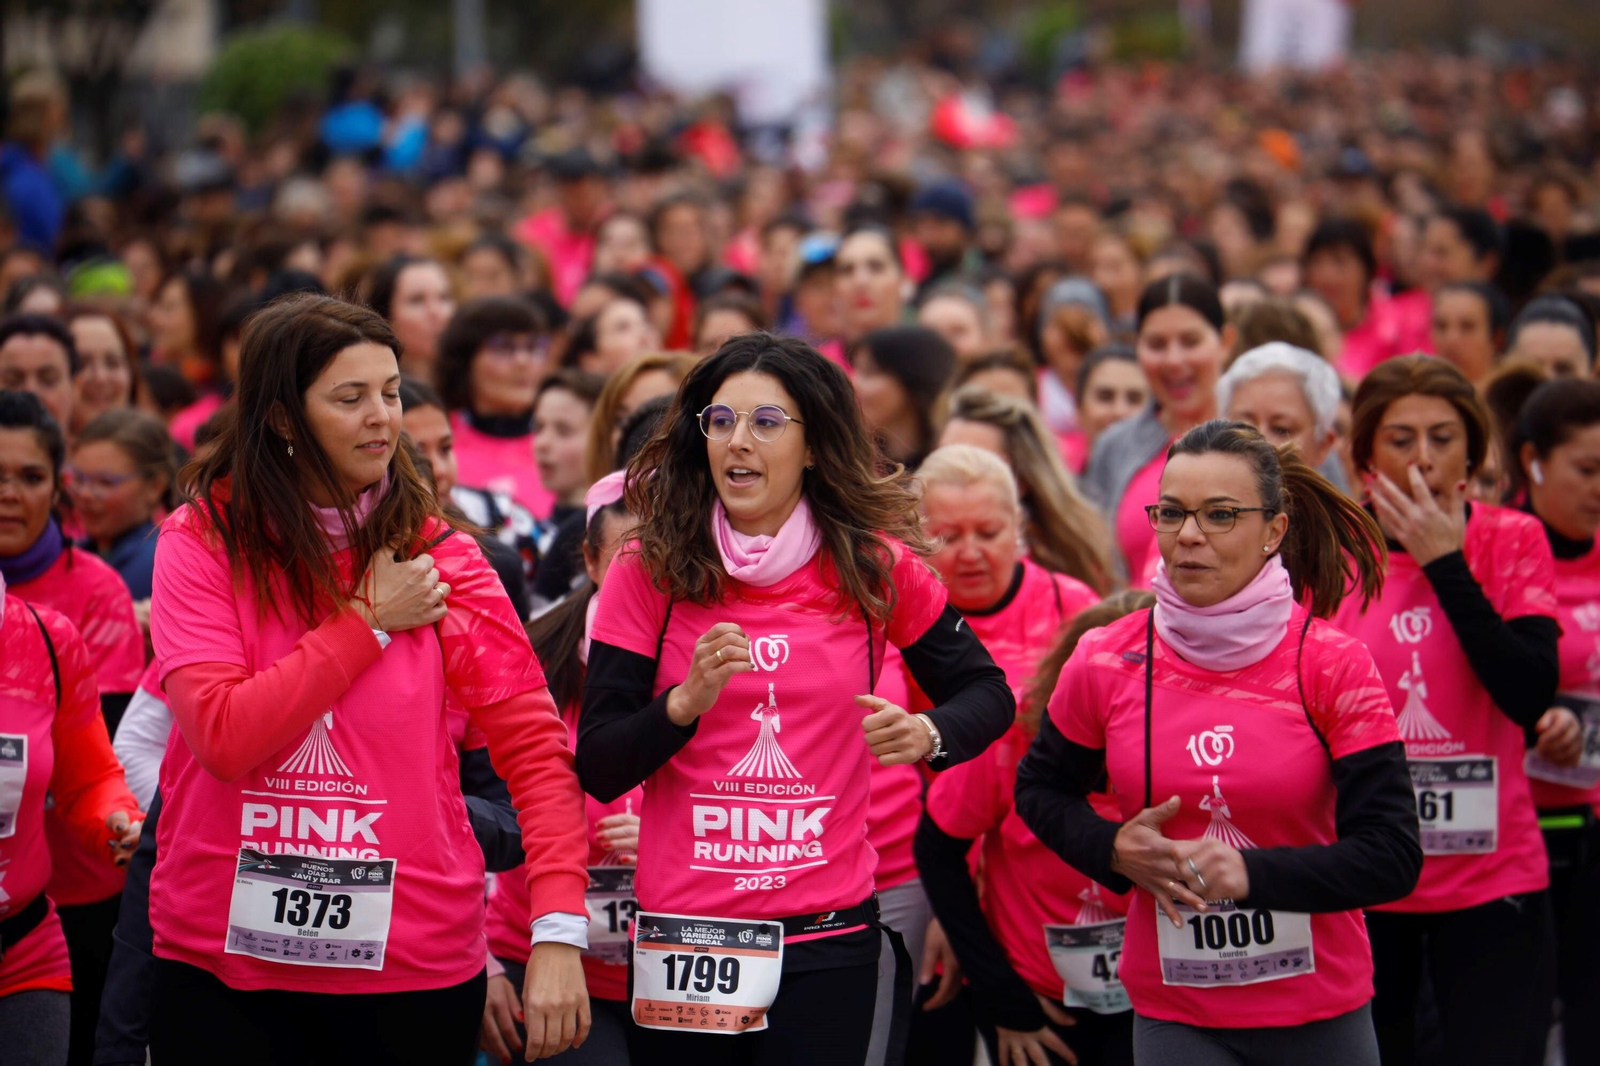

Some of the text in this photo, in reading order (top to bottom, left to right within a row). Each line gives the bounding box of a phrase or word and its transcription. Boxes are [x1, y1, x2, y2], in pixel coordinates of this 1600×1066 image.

[264, 777, 368, 796] VIII EDICIÓN
[713, 781, 816, 796] VIII EDICIÓN
[240, 802, 384, 845] PINK
[692, 804, 832, 842] PINK
[693, 841, 824, 864] RUNNING
[301, 863, 335, 873] BUENOS
[307, 870, 326, 878] DÍAS
[291, 872, 312, 882] JAVI
[733, 875, 787, 892] 2023
[272, 887, 353, 930] 1373
[297, 928, 319, 938] Belén
[694, 927, 725, 935] MEJOR
[1187, 908, 1275, 950] 1000
[680, 932, 726, 941] VARIEDAD
[681, 938, 723, 946] MUSICAL
[1219, 950, 1248, 959] Lourdes
[662, 953, 740, 994] 1799
[686, 993, 710, 1003] Miriam
